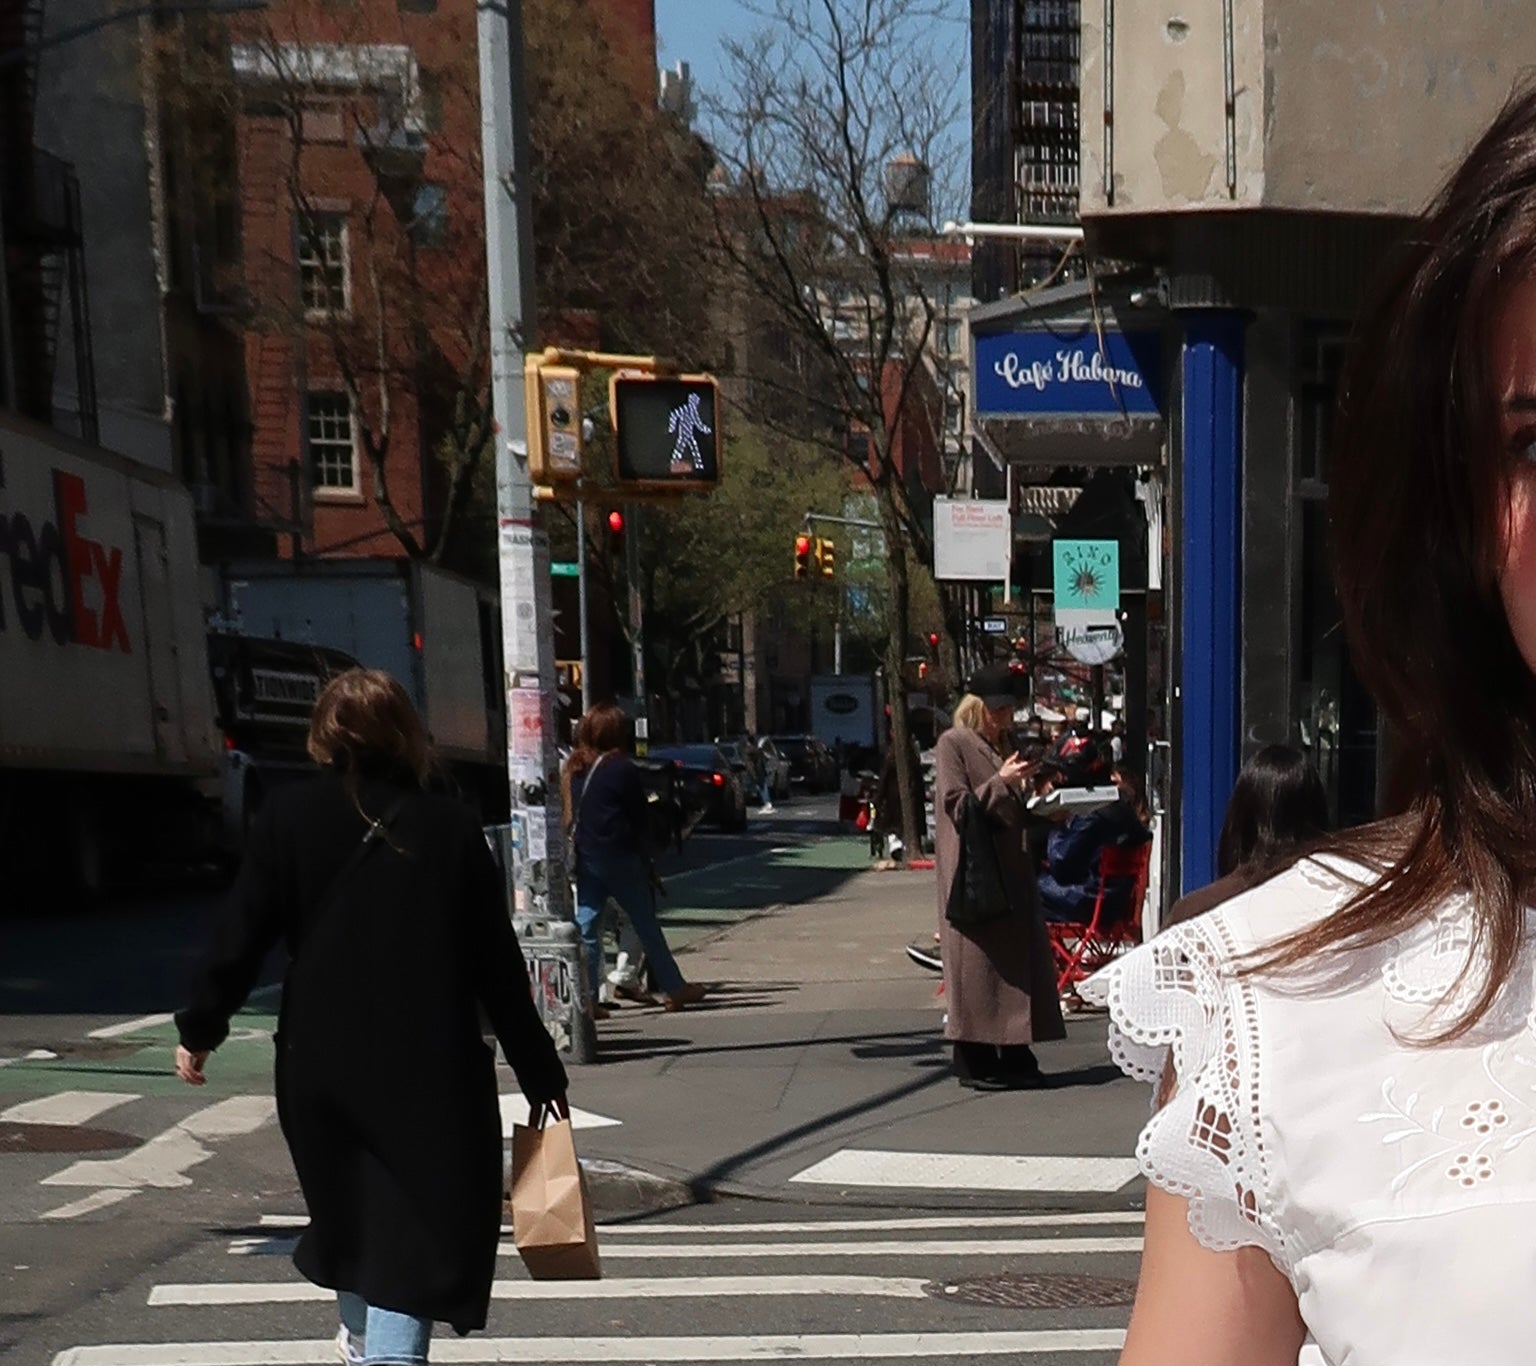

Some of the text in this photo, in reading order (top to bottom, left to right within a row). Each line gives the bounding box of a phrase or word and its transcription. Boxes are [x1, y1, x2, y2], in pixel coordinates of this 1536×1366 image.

[994, 349, 1143, 391] Café Habana
[0, 446, 133, 654] edEx
